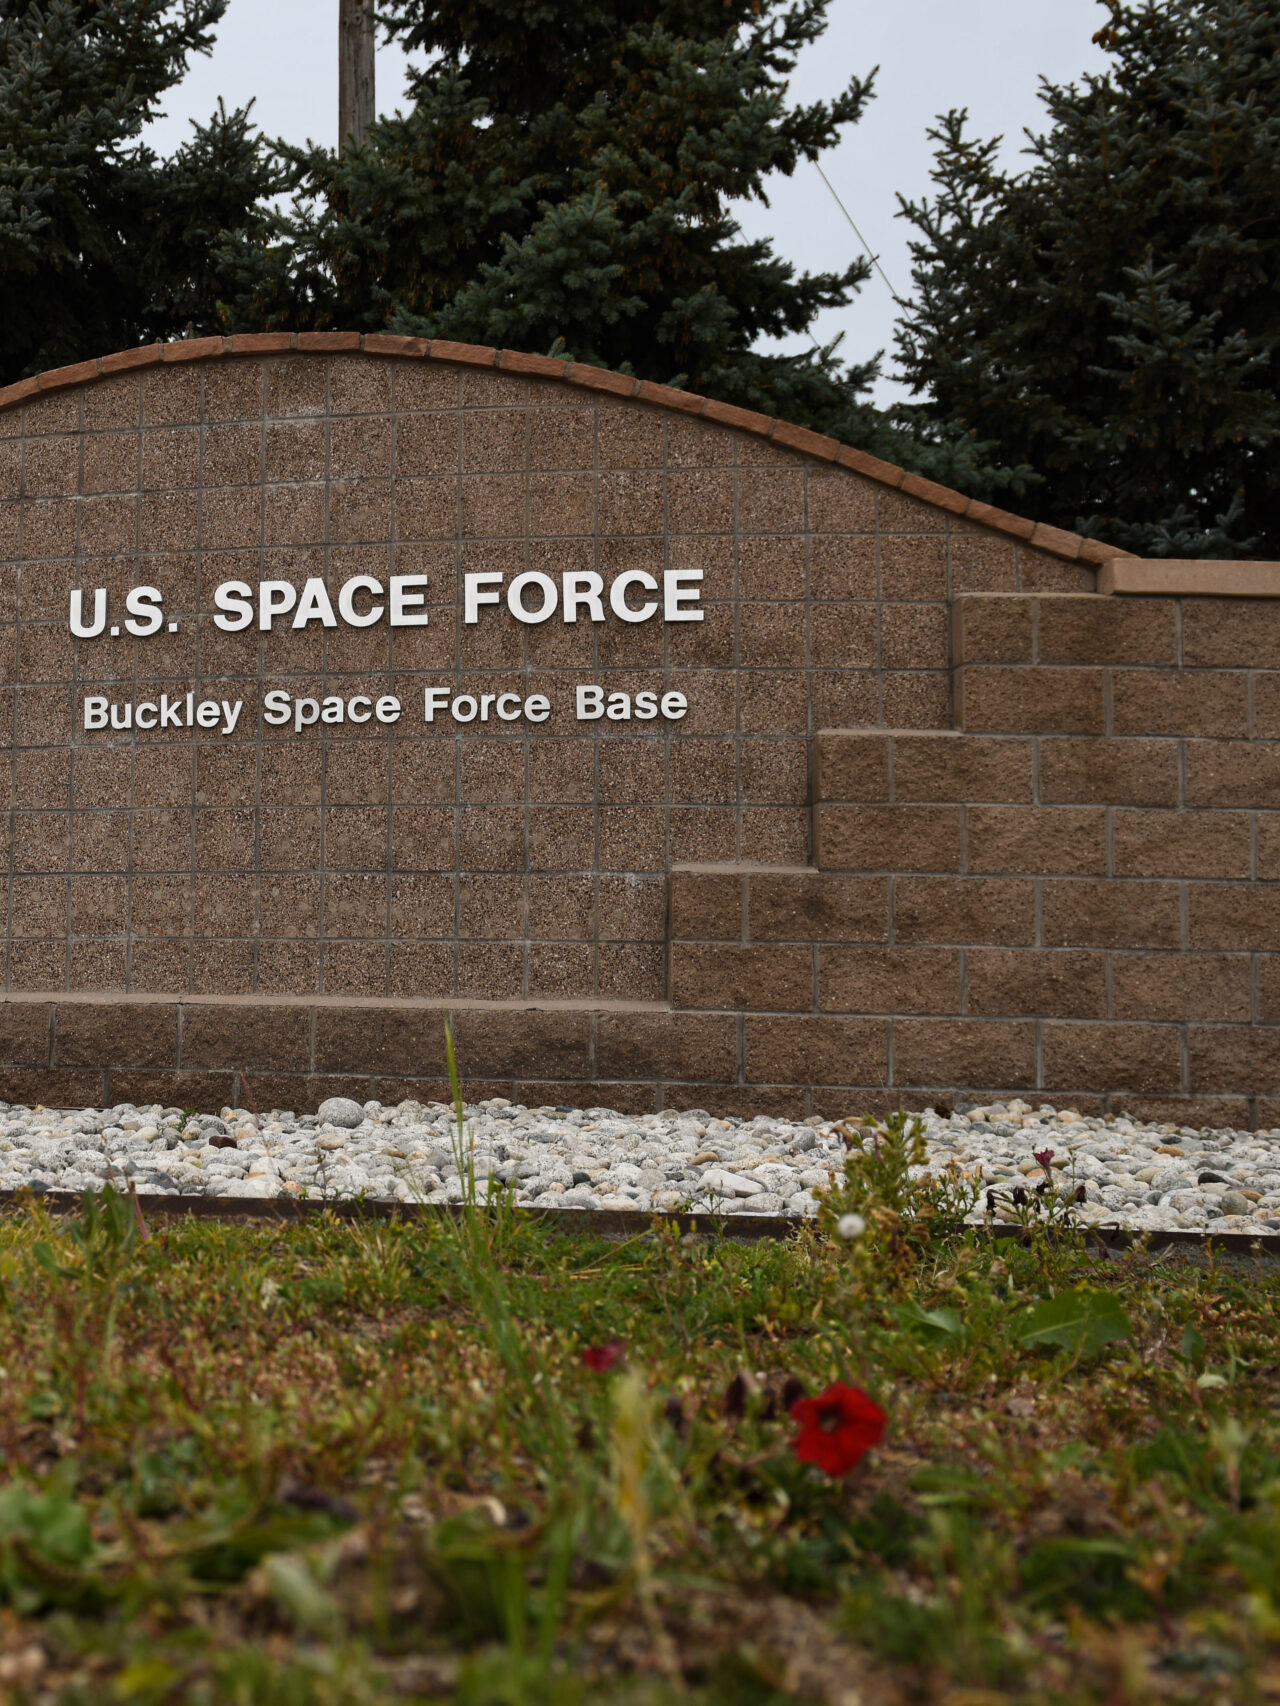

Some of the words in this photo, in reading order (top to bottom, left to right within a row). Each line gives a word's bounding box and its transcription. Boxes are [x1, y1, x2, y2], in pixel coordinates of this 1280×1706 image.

[69, 585, 178, 638] U.S.
[213, 574, 429, 632] SPACE
[464, 568, 705, 624] FORCE
[83, 690, 243, 734] Buckley
[263, 689, 401, 733] Space
[424, 687, 551, 722] Force
[576, 684, 688, 720] Base
